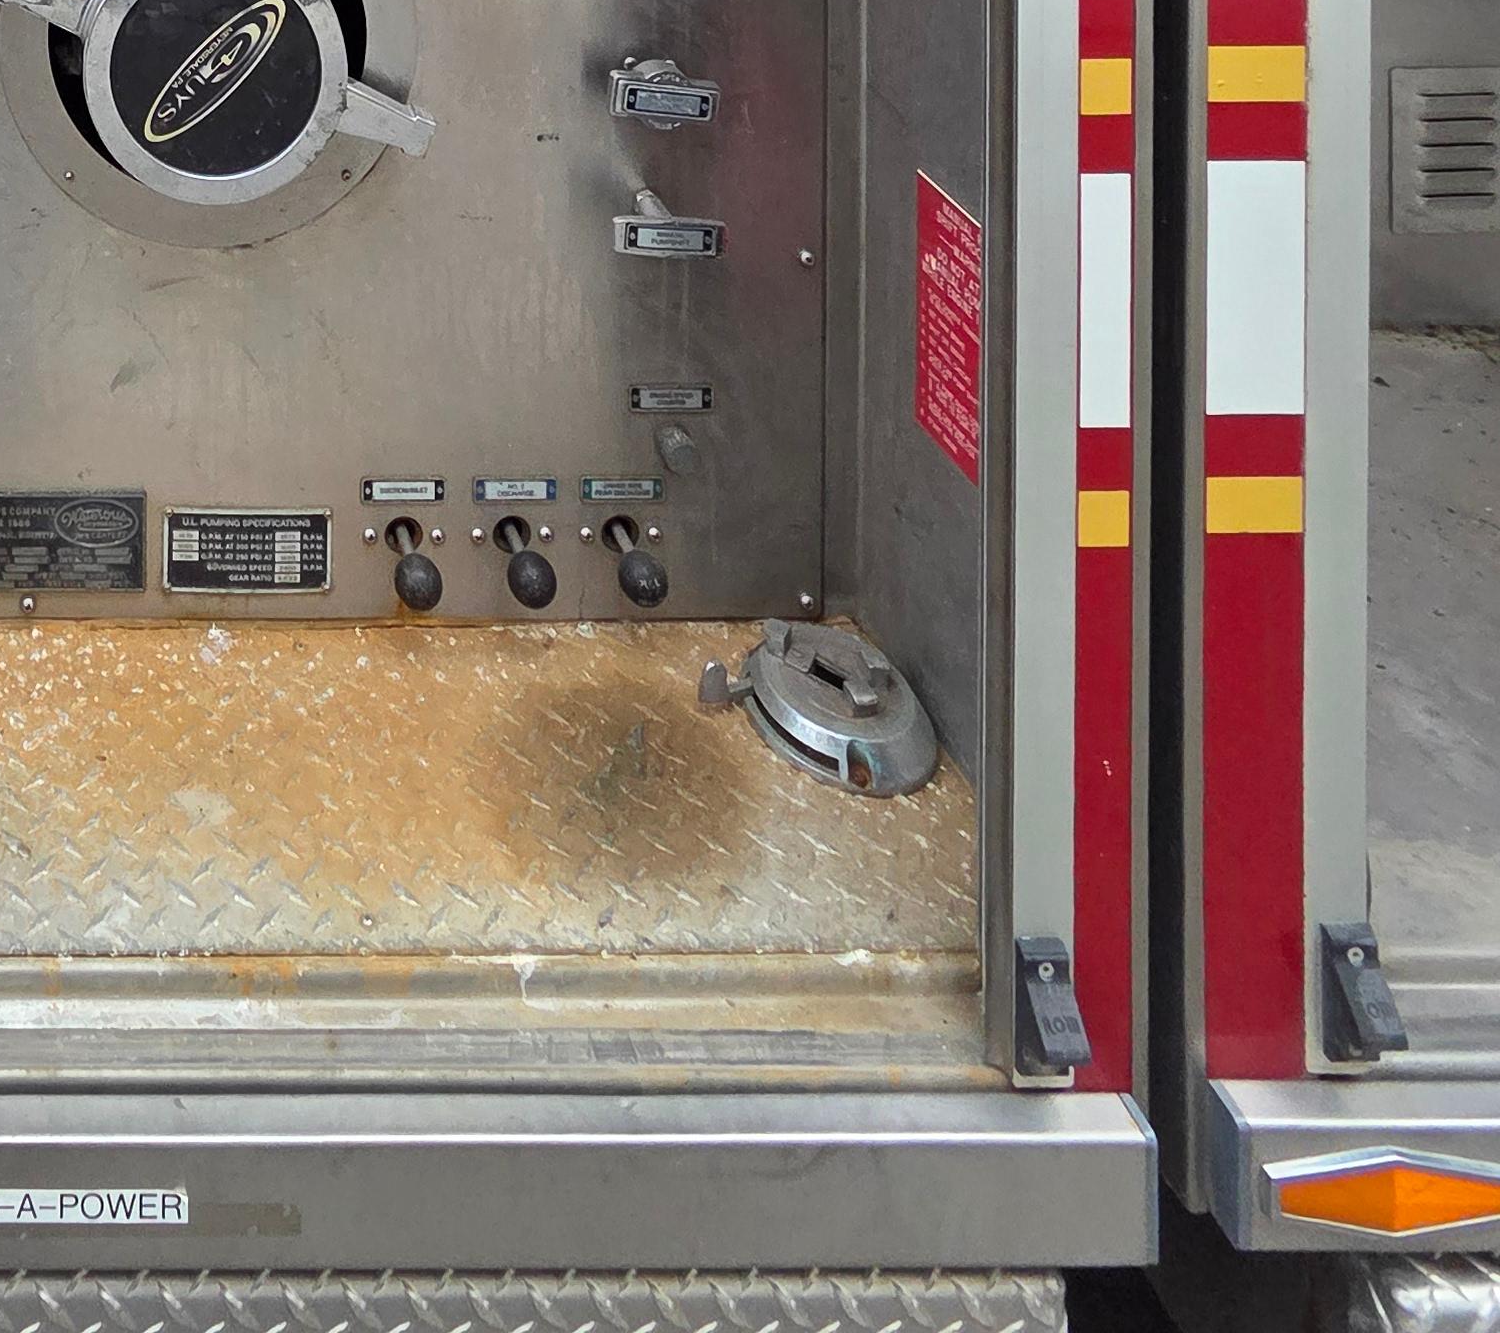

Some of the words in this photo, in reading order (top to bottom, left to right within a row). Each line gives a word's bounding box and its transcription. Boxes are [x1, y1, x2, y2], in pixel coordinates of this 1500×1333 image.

[172, 77, 184, 89] PA
[9, 506, 56, 516] COMPANY
[200, 518, 240, 527] PUMPING
[242, 519, 311, 528] SPECIFICATIONS
[229, 574, 250, 582] GEAR
